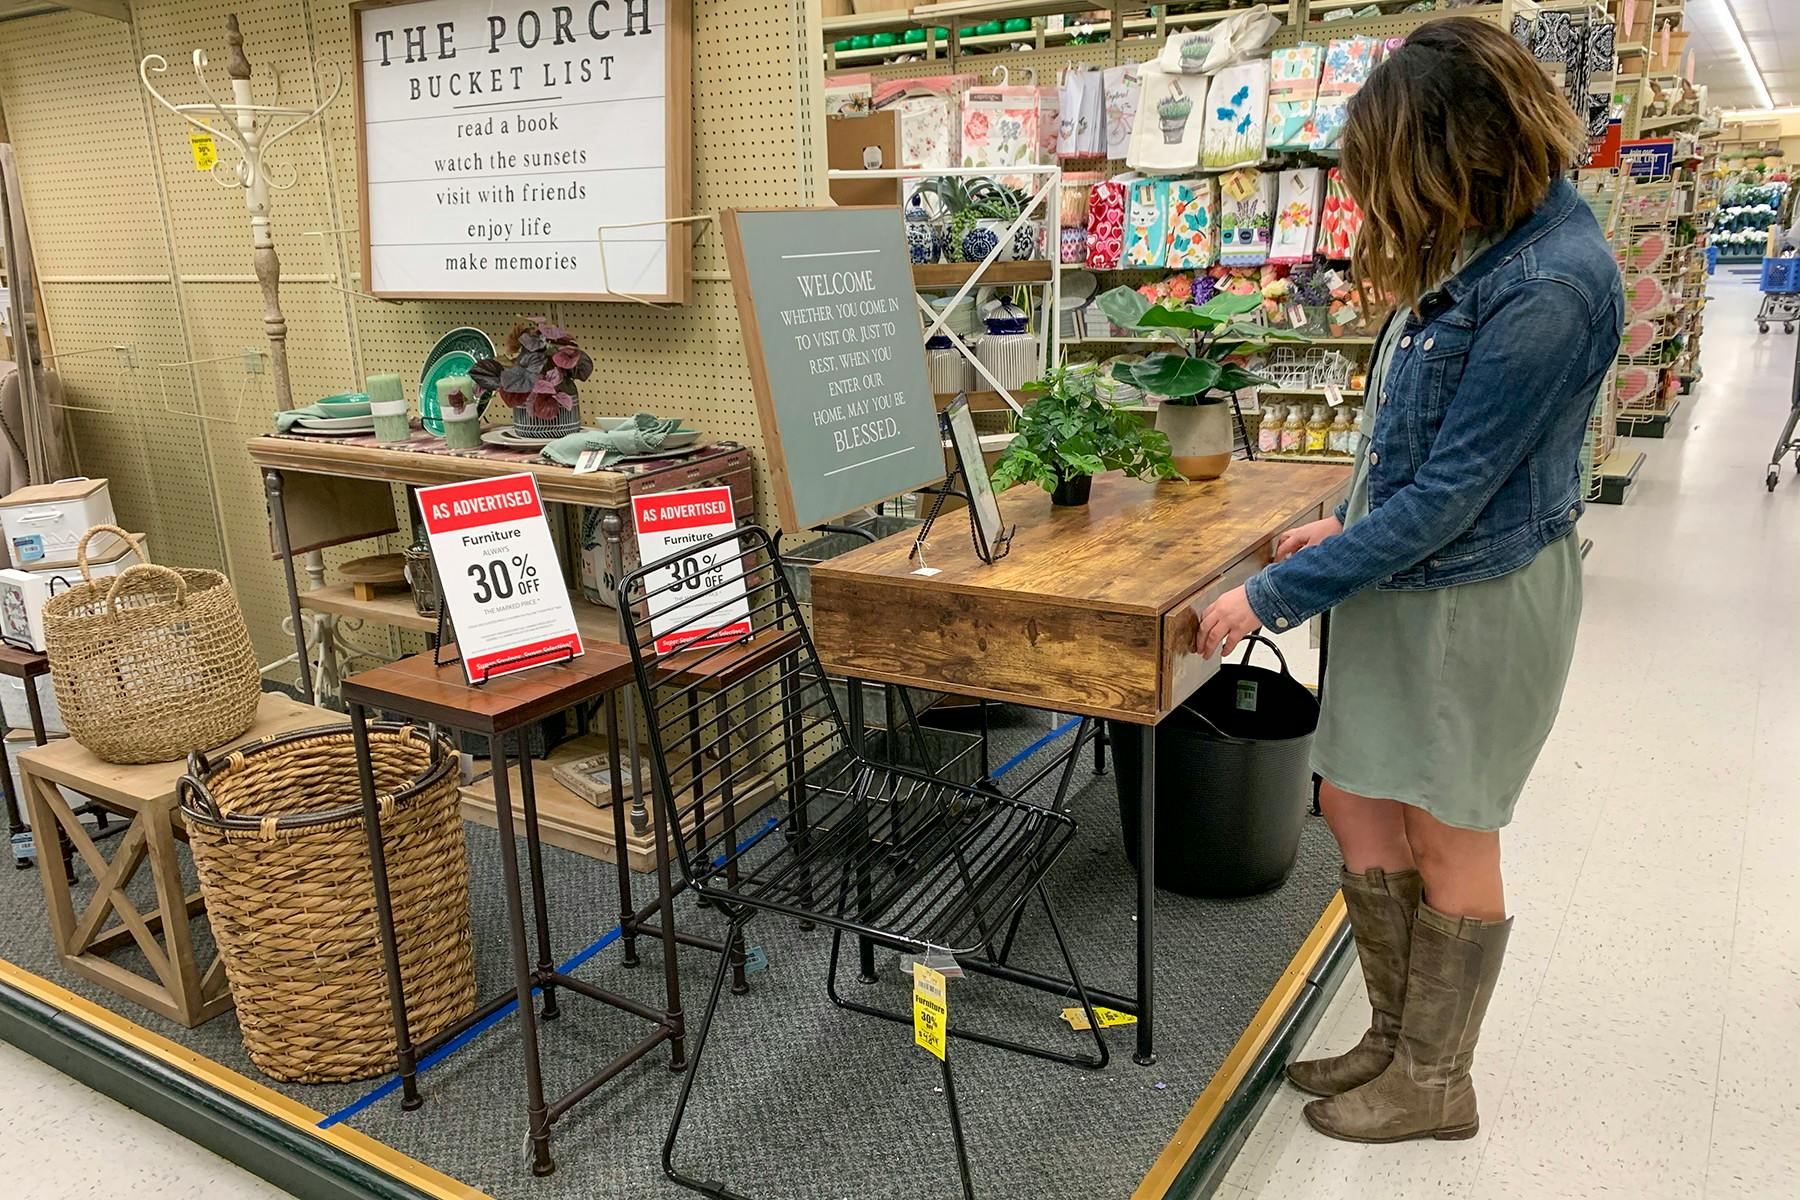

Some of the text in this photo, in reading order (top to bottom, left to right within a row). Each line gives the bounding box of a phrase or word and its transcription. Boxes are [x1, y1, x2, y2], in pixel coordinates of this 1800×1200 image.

[376, 0, 652, 66] THE PORCH
[410, 56, 614, 100] BUCKET LIST
[457, 112, 558, 138] read a book
[434, 148, 586, 172] watch the sunsets
[436, 181, 586, 205] visit with friends
[468, 218, 551, 241] enjoy life
[446, 251, 577, 270] make memories
[797, 270, 876, 298] WELCOME
[780, 297, 900, 326] WHETHER YOU COME IN
[795, 322, 896, 351] TO VISIT OR JUST TO
[810, 346, 892, 376] REST. WHEN YOU
[829, 372, 885, 397] ENTER OUR
[813, 392, 906, 427] HOME, MAY YOU BE
[833, 416, 900, 452] BLESSED.
[432, 490, 532, 520] AS ADVERTISED
[643, 500, 726, 522] AS ADVERTISED
[462, 528, 521, 547] Furniture
[664, 532, 714, 546] Furniture
[482, 546, 510, 556] ALWAYS
[518, 578, 540, 595] OFF
[705, 574, 723, 588] OFF
[916, 994, 944, 1014] Furniture
[921, 1012, 938, 1027] 30%
